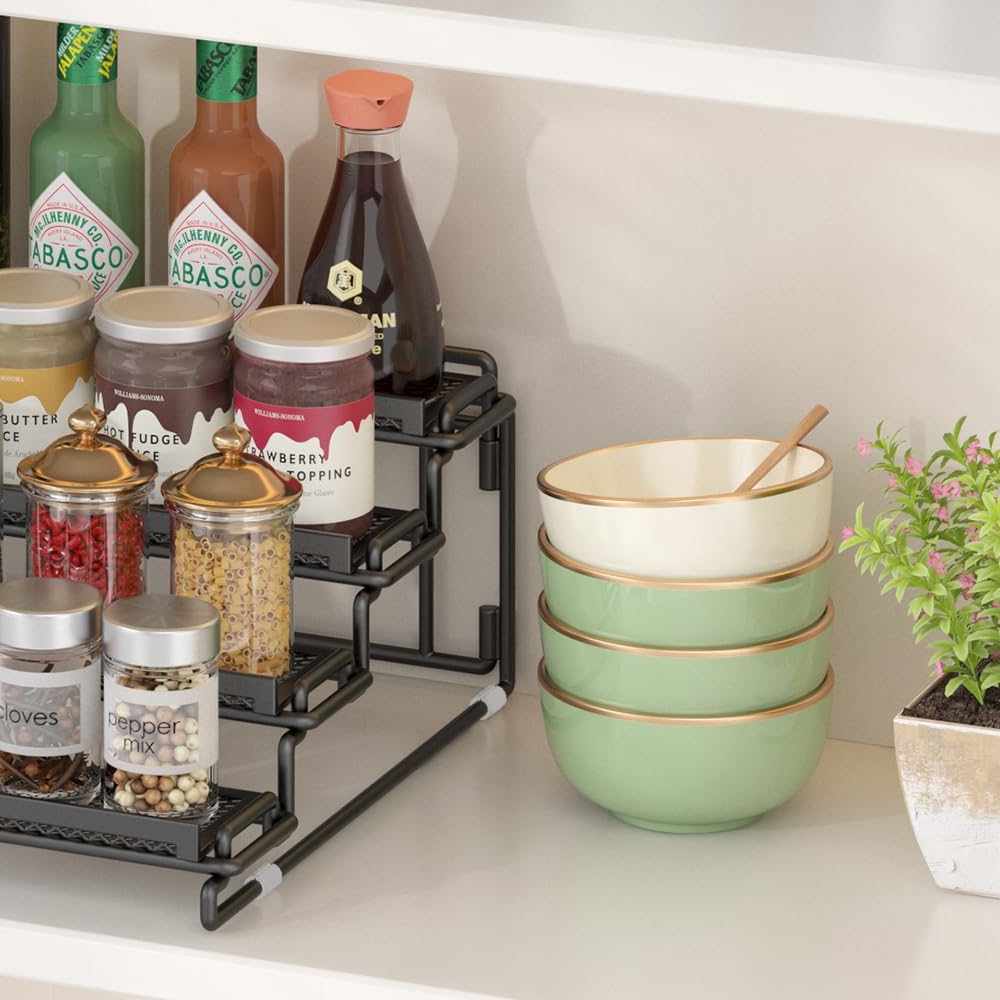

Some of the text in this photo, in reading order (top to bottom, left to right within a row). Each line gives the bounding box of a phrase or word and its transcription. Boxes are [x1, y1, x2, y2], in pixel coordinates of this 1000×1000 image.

[57, 26, 80, 59] MILDER
[87, 225, 103, 247] CO.
[32, 240, 123, 270] ABASCO
[227, 244, 244, 265] CO.
[91, 271, 107, 291] UCE
[171, 259, 264, 289] ABASCO
[113, 388, 165, 402] WILLIAMS-SONOMA
[254, 408, 305, 421] WILLIAMS-SONOMA
[103, 425, 180, 445] HOT FUDGE
[108, 709, 182, 737] pepper
[122, 735, 156, 755] mix
